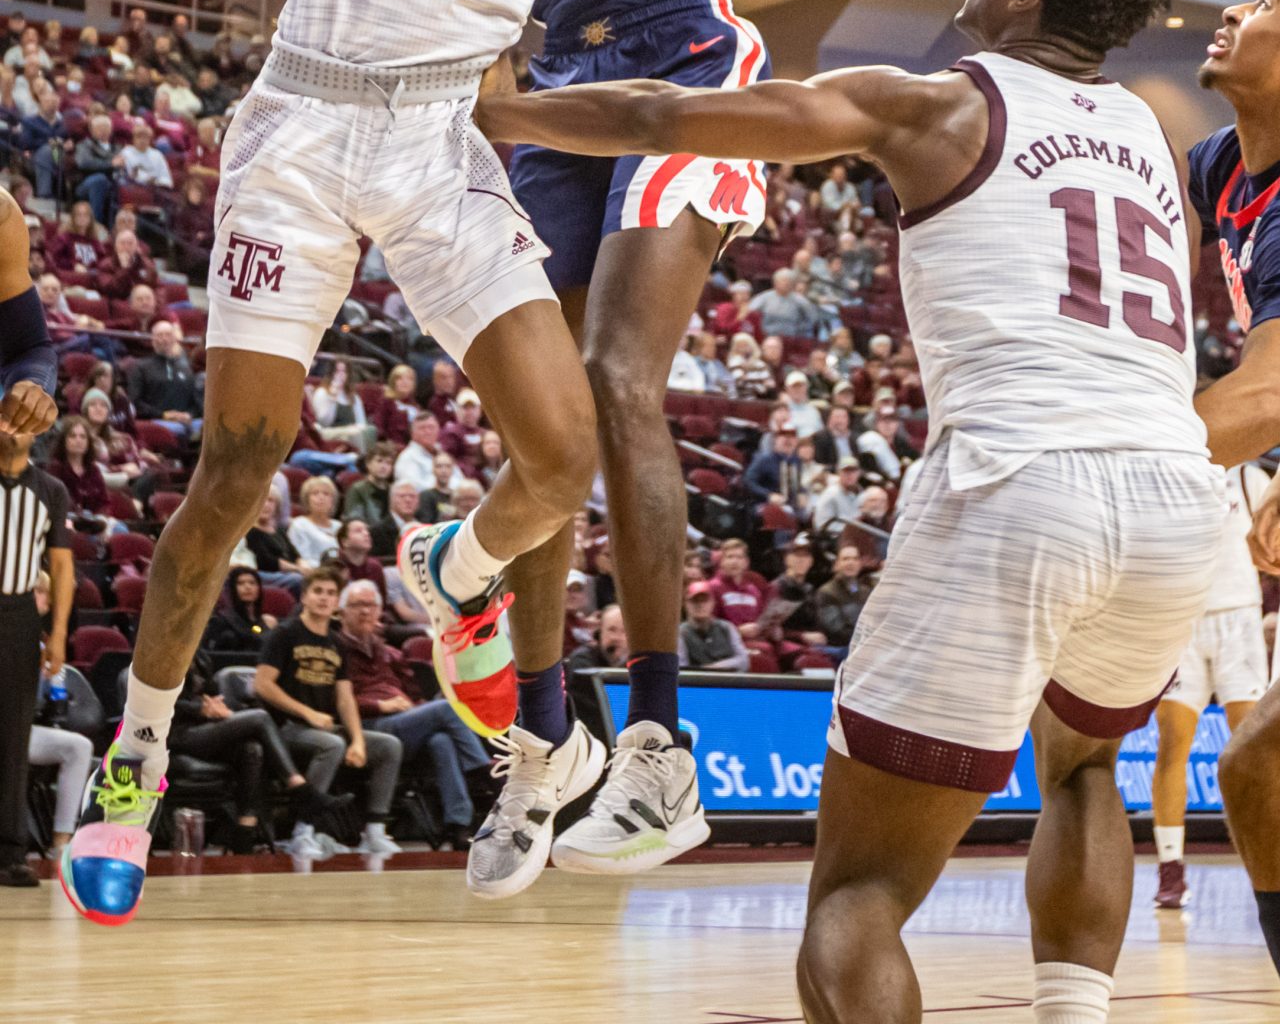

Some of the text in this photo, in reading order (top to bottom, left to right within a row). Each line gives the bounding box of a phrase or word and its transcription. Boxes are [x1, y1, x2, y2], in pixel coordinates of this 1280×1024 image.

[1013, 134, 1154, 186] COLEMAN
[1050, 186, 1187, 354] 15
[705, 751, 763, 798] St.
